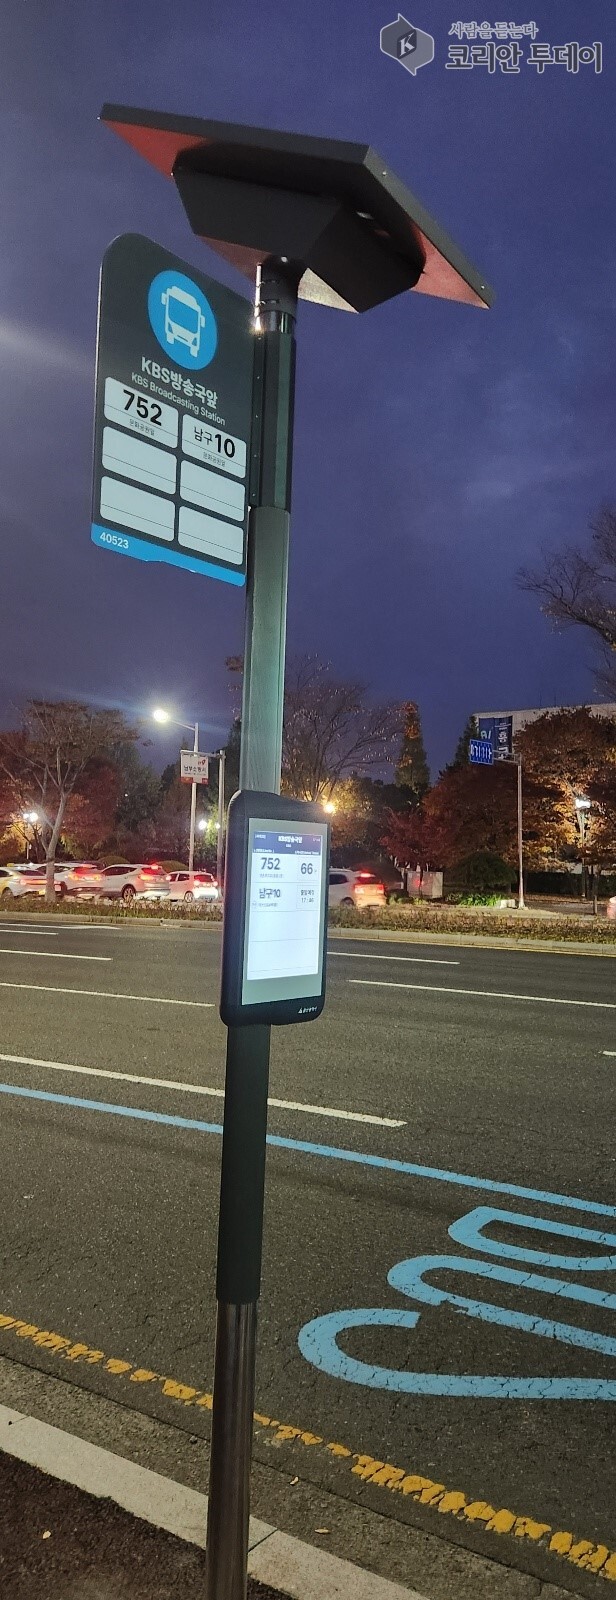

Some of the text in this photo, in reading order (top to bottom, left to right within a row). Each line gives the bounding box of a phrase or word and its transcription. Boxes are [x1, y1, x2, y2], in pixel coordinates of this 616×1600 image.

[141, 356, 218, 410] KBS방송국앞
[123, 389, 162, 427] 752
[131, 372, 226, 426] KBS Broadcasting Station
[194, 425, 236, 458] 남구10
[100, 531, 129, 549] 40523
[261, 857, 281, 870] 752
[300, 862, 314, 875] 66
[259, 888, 281, 899] 남구10
